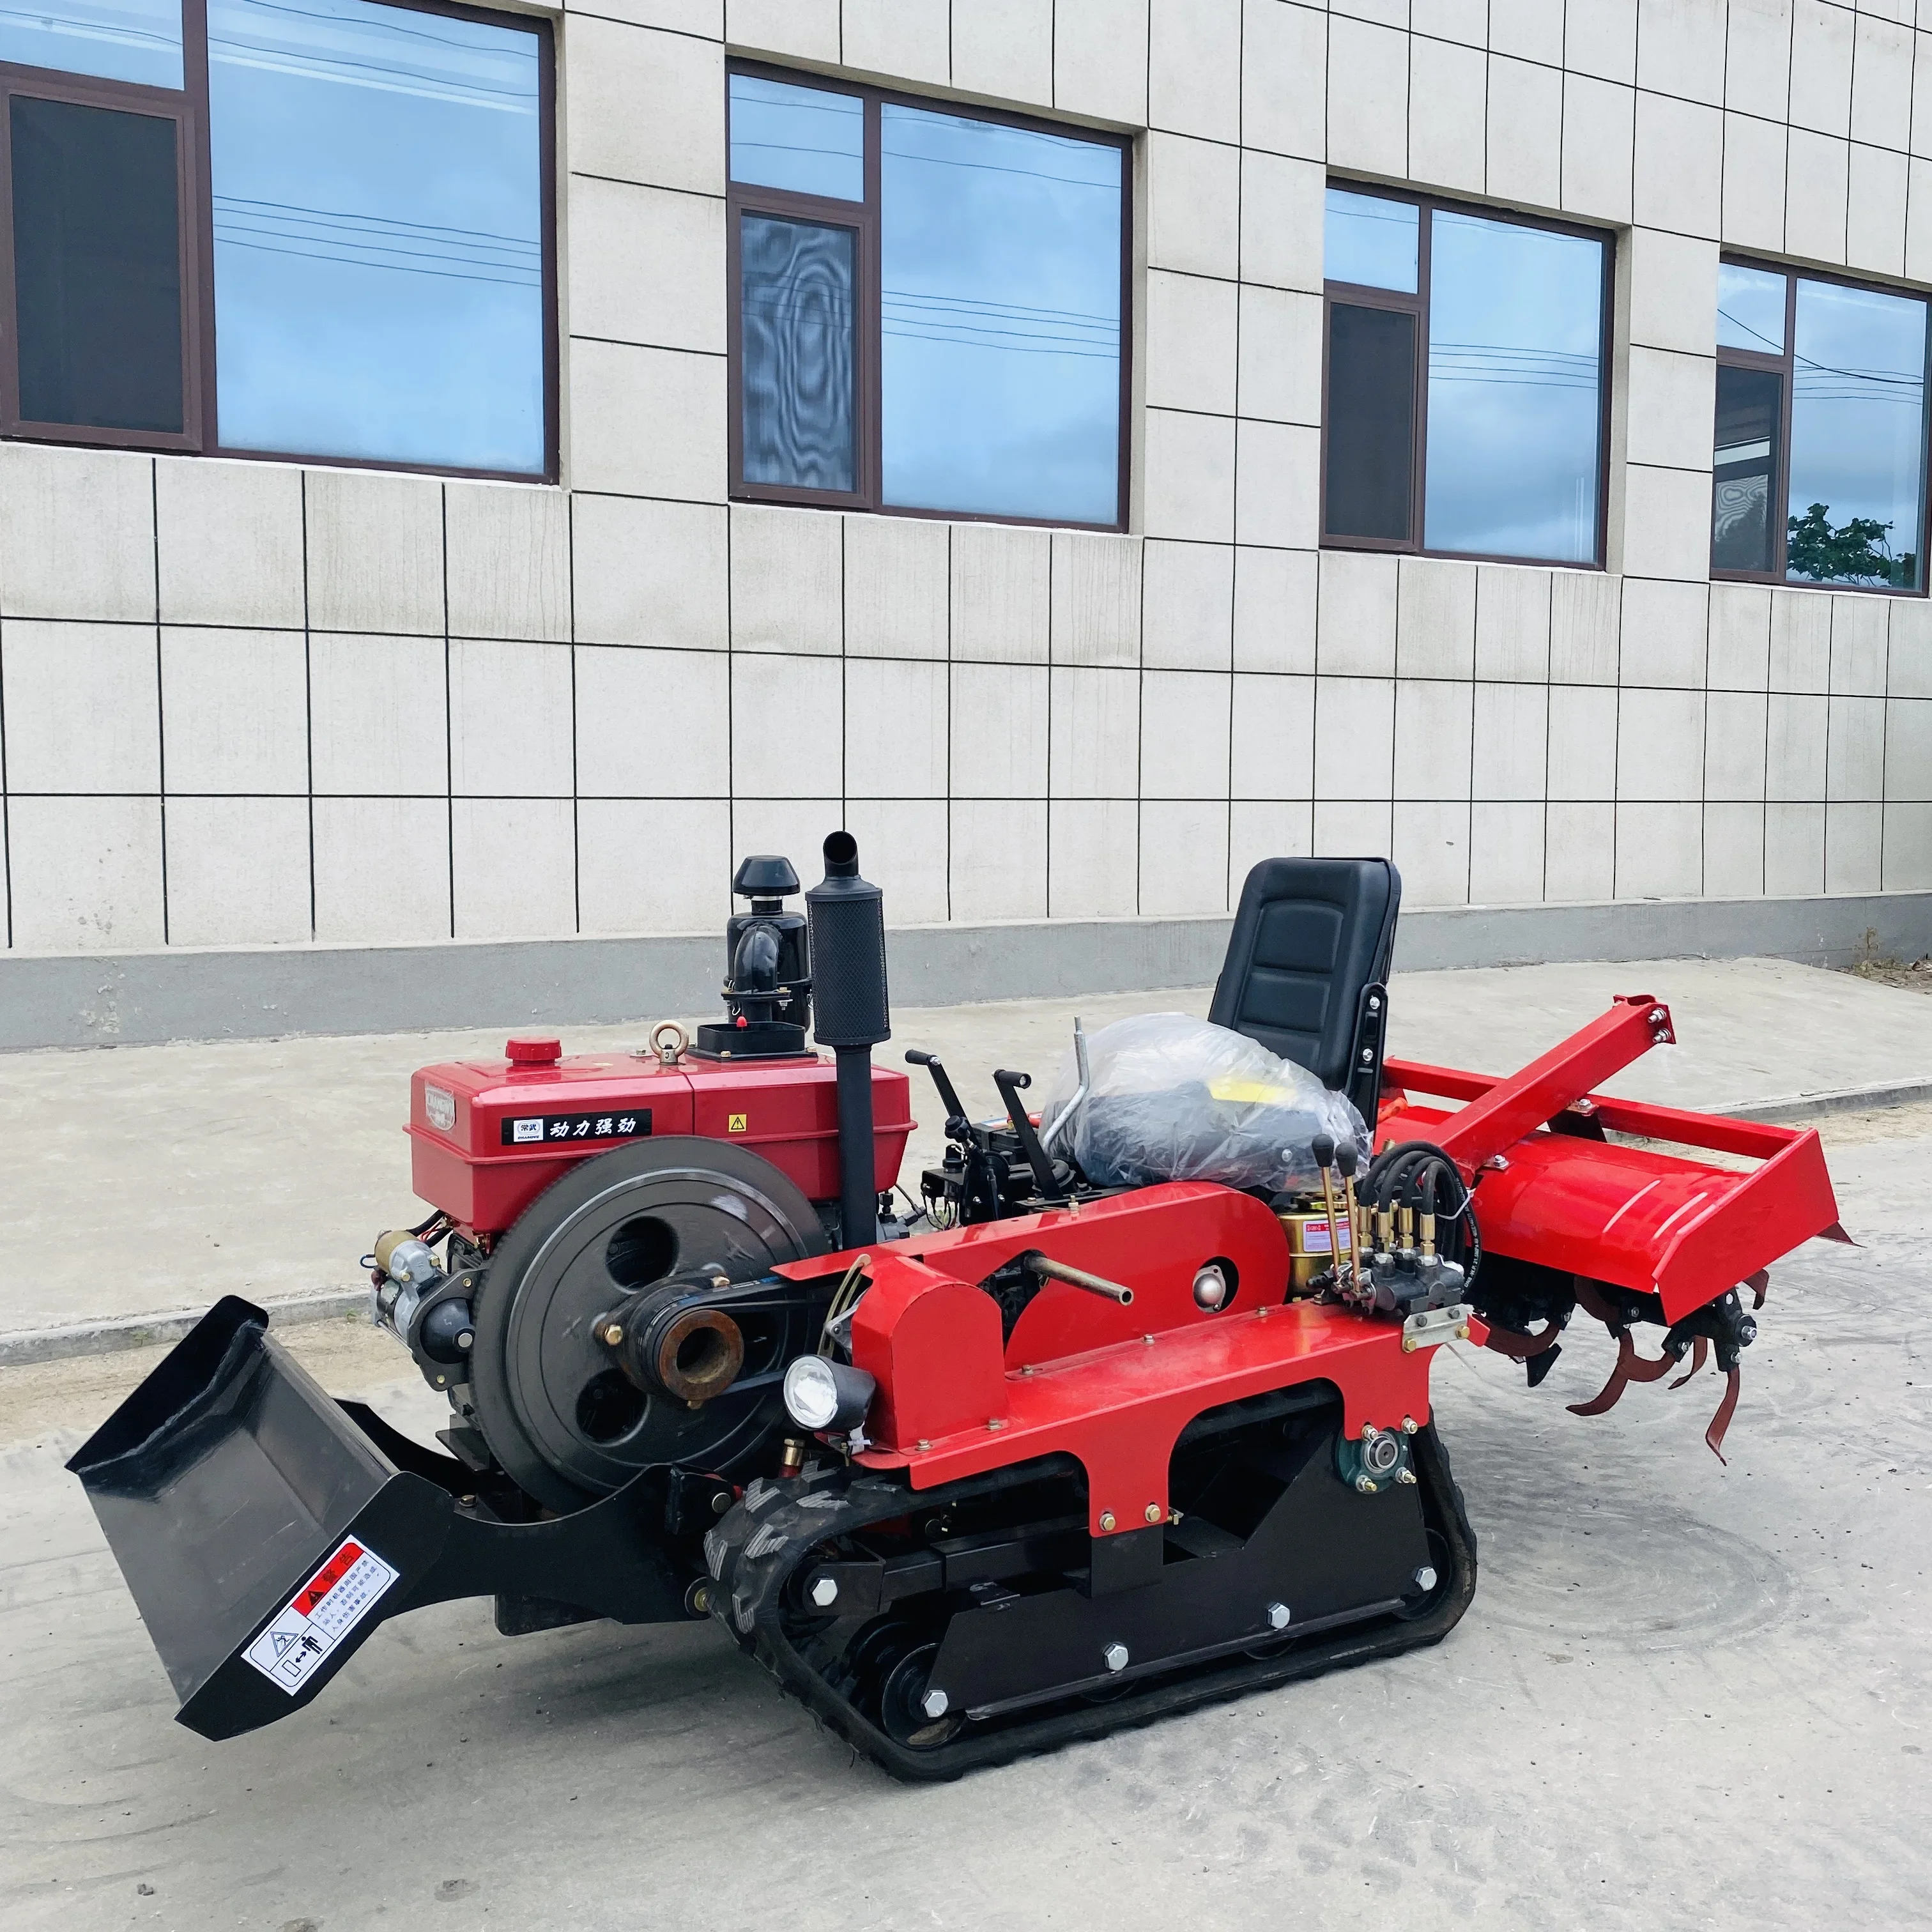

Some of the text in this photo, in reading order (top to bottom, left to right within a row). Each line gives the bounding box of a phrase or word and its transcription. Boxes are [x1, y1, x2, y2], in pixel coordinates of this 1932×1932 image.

[550, 1118, 636, 1137] 动力强劲
[322, 1551, 354, 1584] 警告
